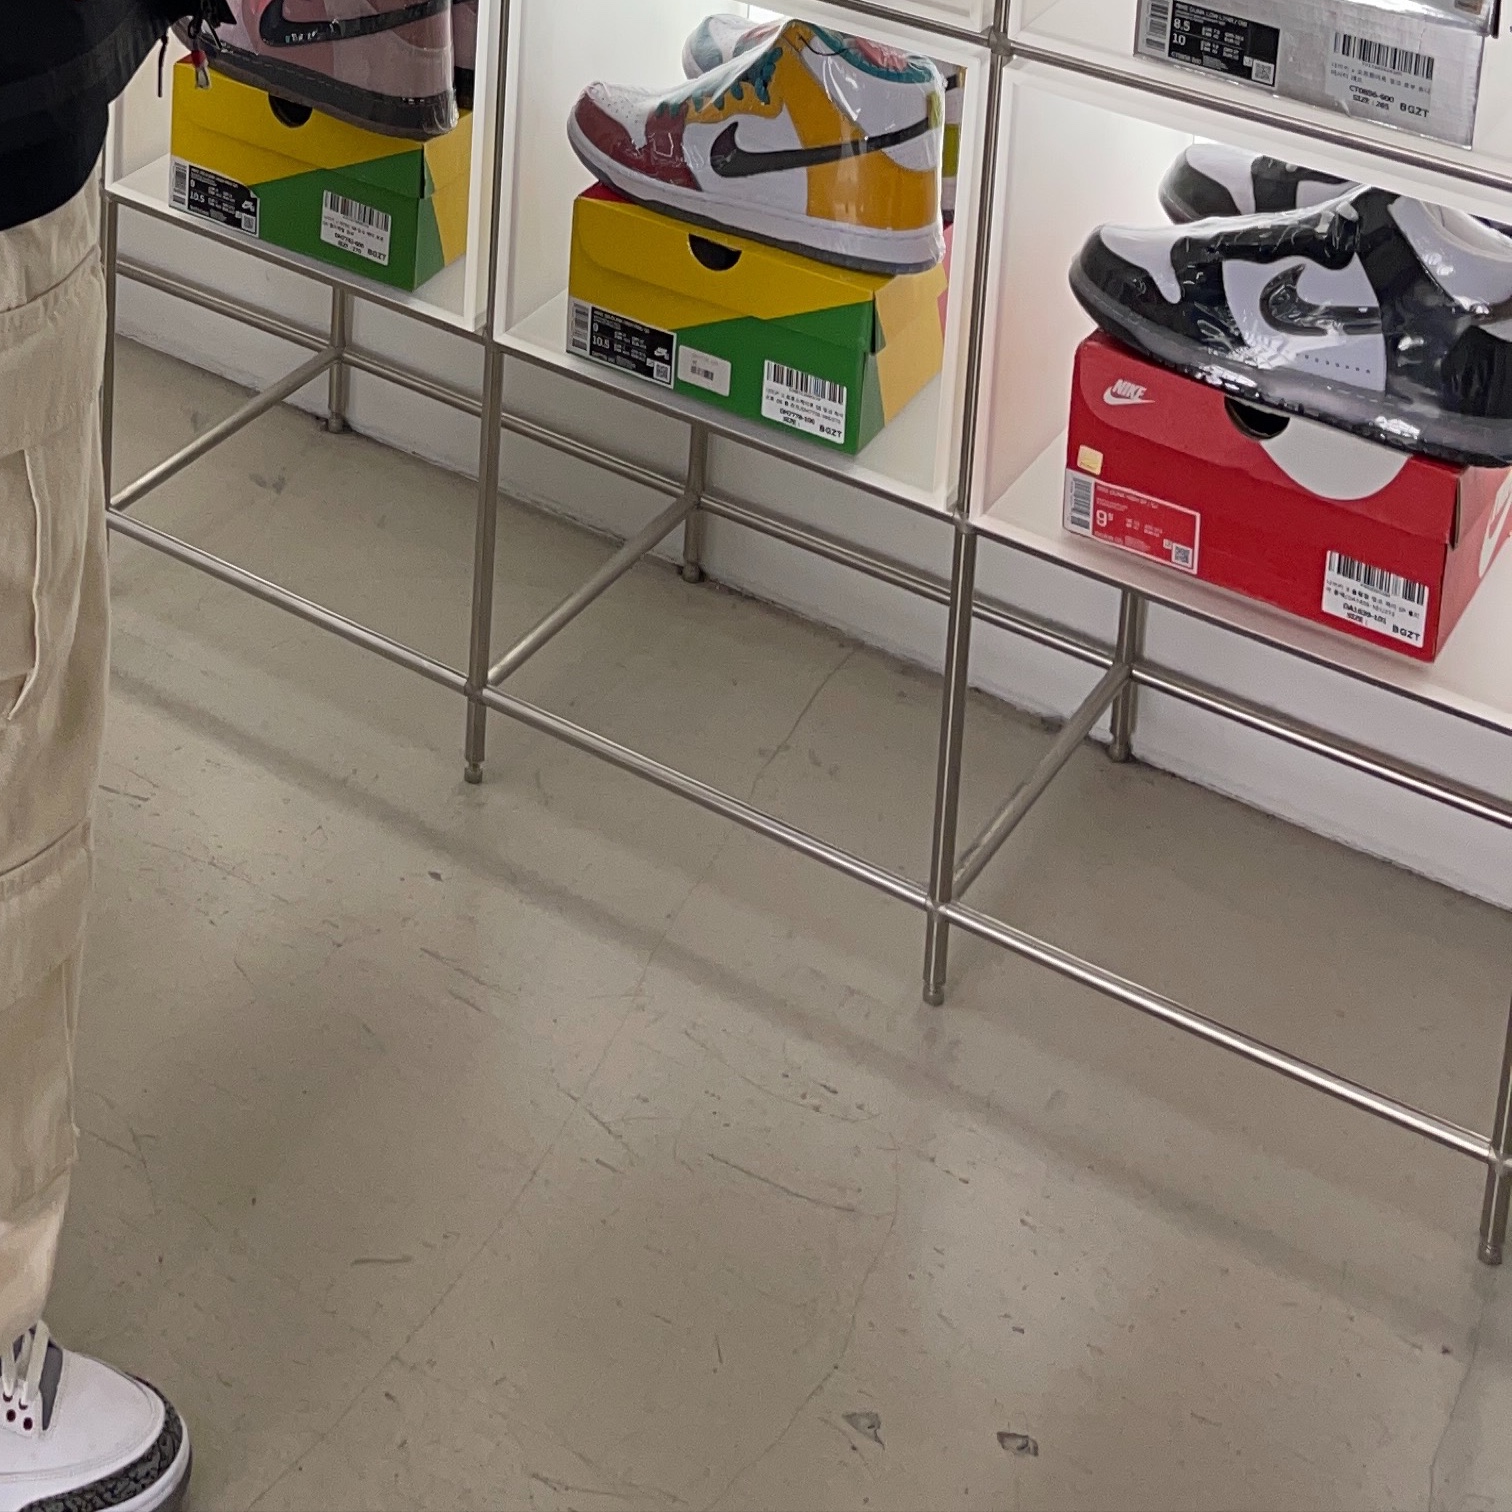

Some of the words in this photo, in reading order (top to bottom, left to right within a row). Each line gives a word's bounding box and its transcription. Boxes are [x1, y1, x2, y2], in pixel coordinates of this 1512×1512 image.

[1173, 18, 1191, 32] 8.5
[1172, 33, 1186, 46] 10
[1399, 102, 1430, 118] BGZT
[592, 335, 610, 349] 10.5
[819, 424, 843, 438] BGZT
[1392, 623, 1421, 641] BGZT
